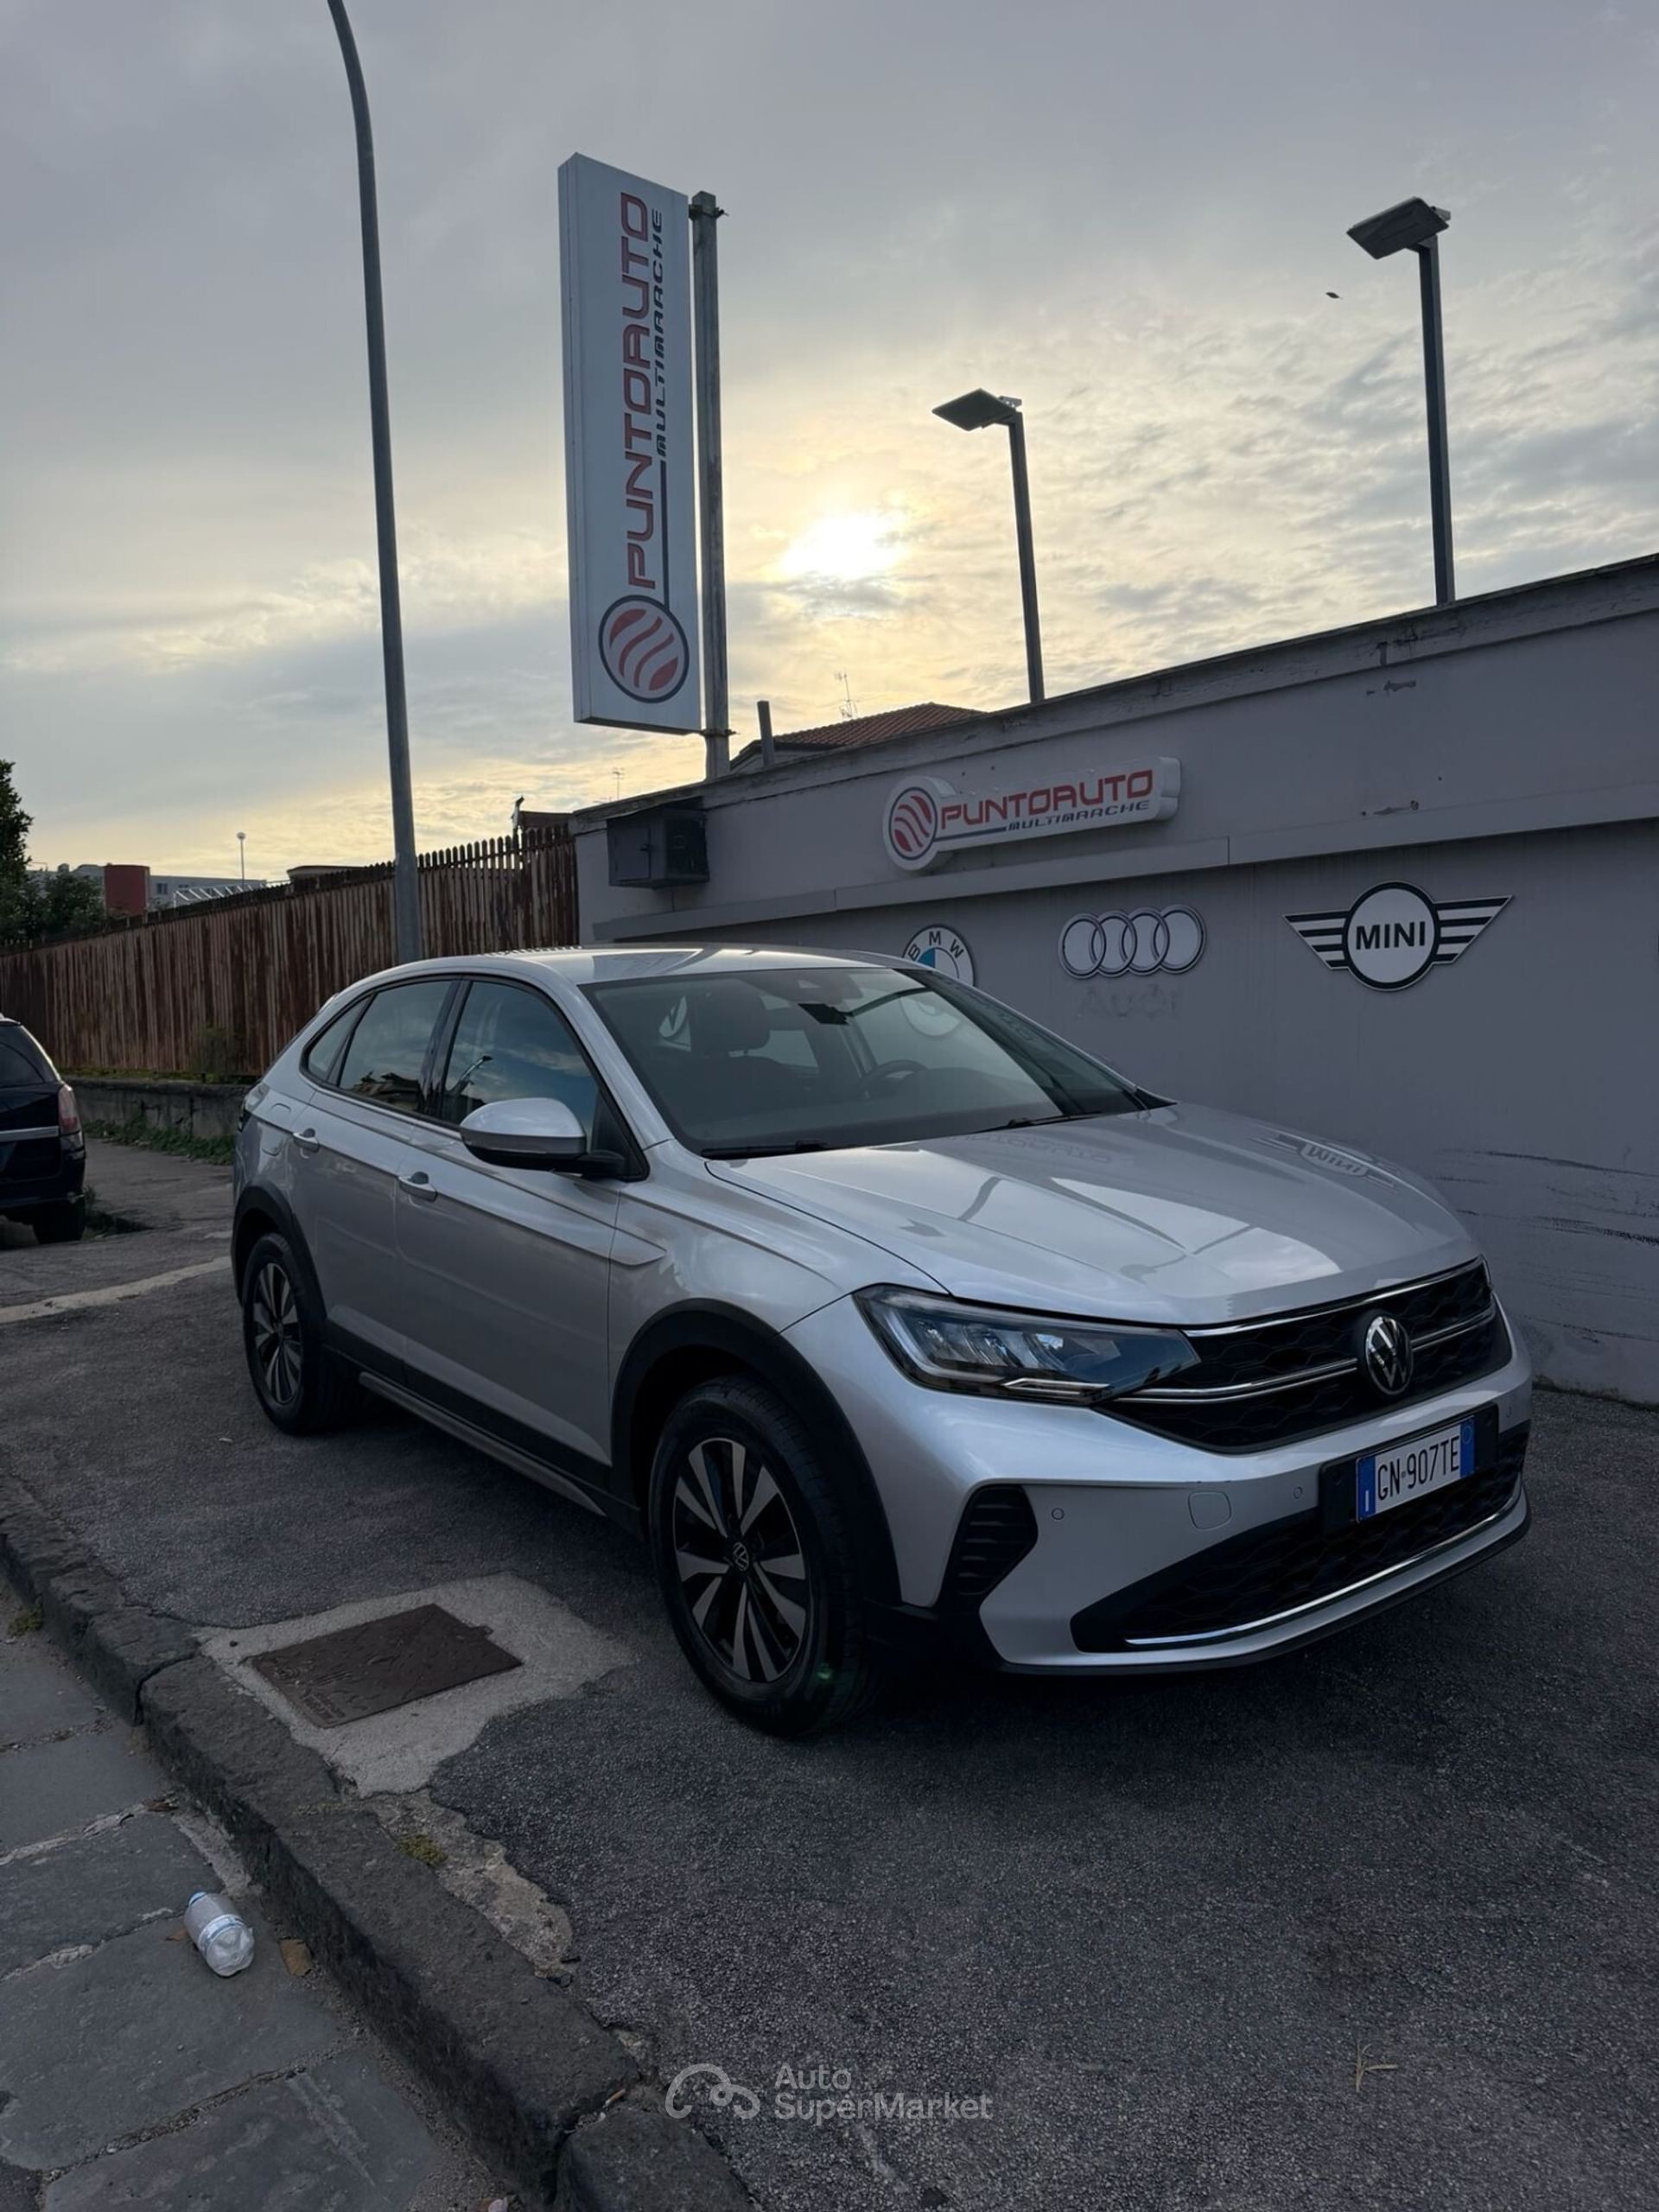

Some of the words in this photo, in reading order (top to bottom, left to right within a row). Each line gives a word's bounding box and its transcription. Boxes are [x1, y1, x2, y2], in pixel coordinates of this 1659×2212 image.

[652, 207, 666, 458] MULTIMARCHE
[620, 192, 656, 589] PUNTOAUTO
[940, 769, 1154, 830] PUNTOAUTO
[1007, 800, 1150, 830] MULTIMARCHE
[907, 931, 965, 961] BMW
[1355, 921, 1427, 950] MINI
